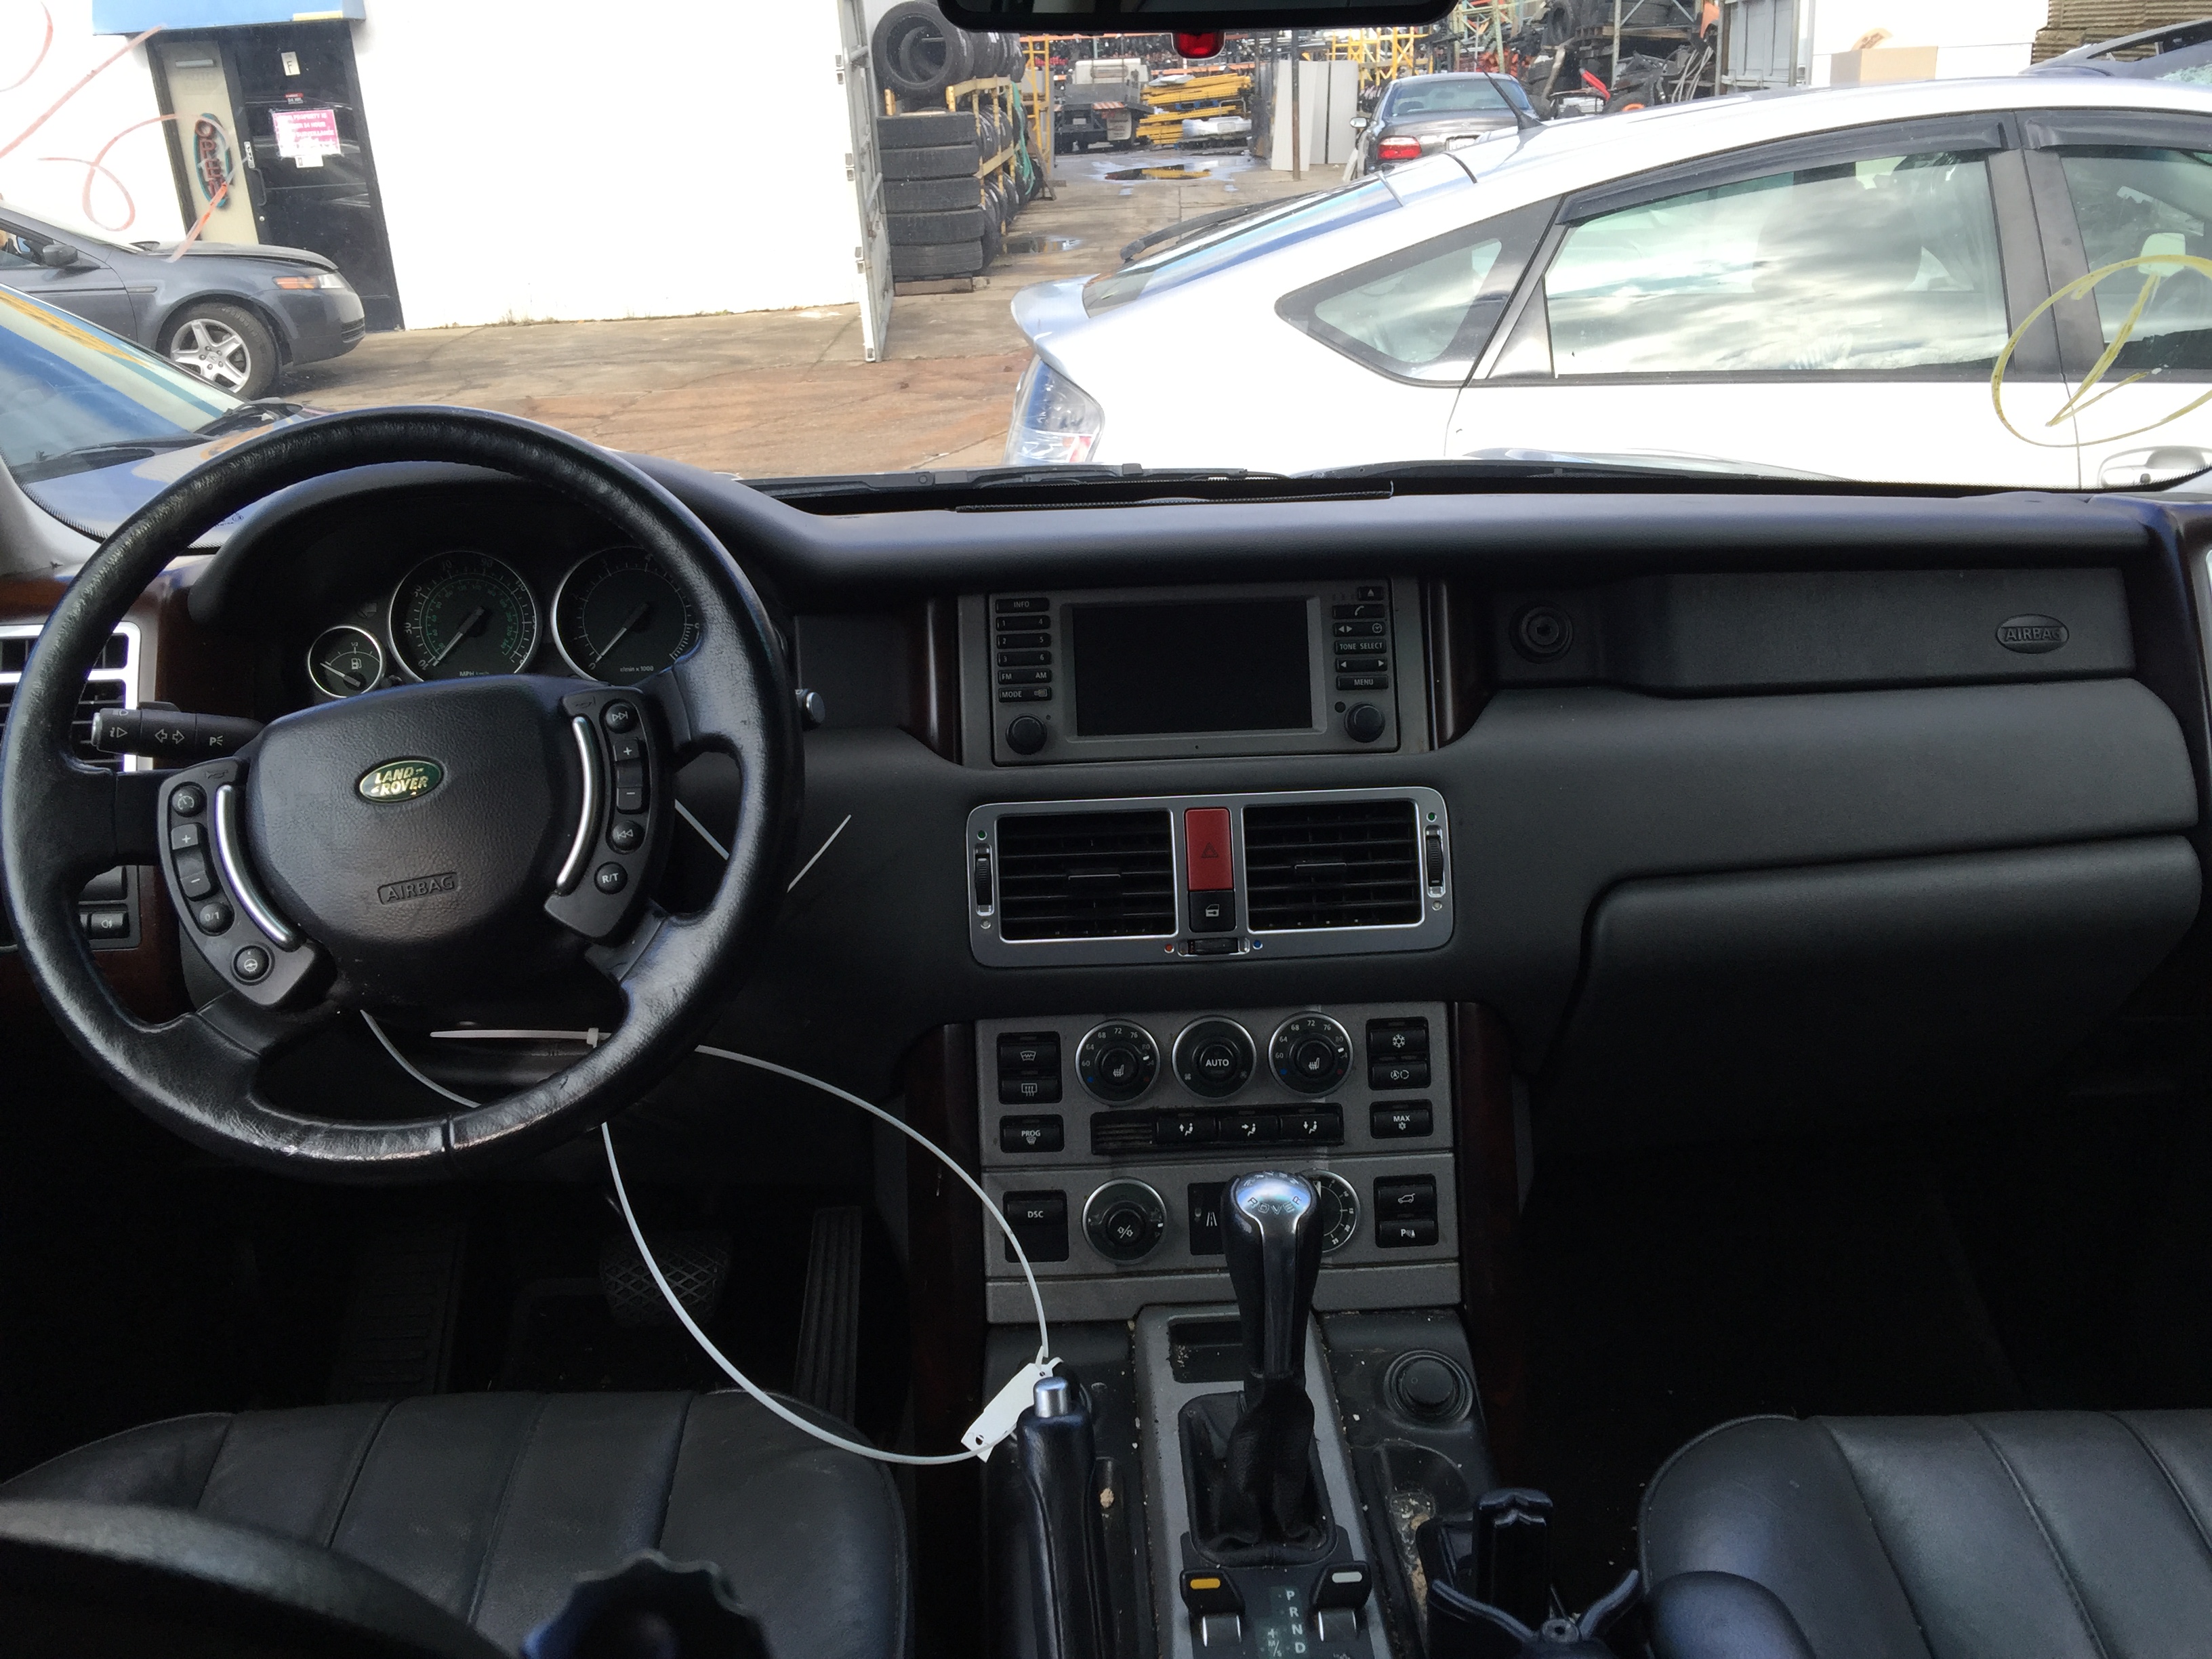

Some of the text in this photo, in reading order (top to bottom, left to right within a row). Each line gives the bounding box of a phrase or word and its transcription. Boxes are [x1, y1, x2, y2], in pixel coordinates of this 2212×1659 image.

[195, 119, 228, 201] OPEN
[2005, 627, 2062, 642] AIRBAG
[1360, 642, 1383, 650] SELECT
[1002, 691, 1023, 699] MODE
[375, 766, 414, 784] LAND
[380, 776, 428, 796] ROVER
[602, 872, 619, 884] R/T
[387, 876, 455, 902] AIRBAG
[1205, 1059, 1230, 1067] AUTO
[1248, 1195, 1302, 1215] ROVER
[1027, 1210, 1044, 1218] DSC
[1286, 1590, 1295, 1601] P
[1289, 1607, 1299, 1617] R
[1291, 1624, 1303, 1635] N
[1294, 1642, 1306, 1654] D
